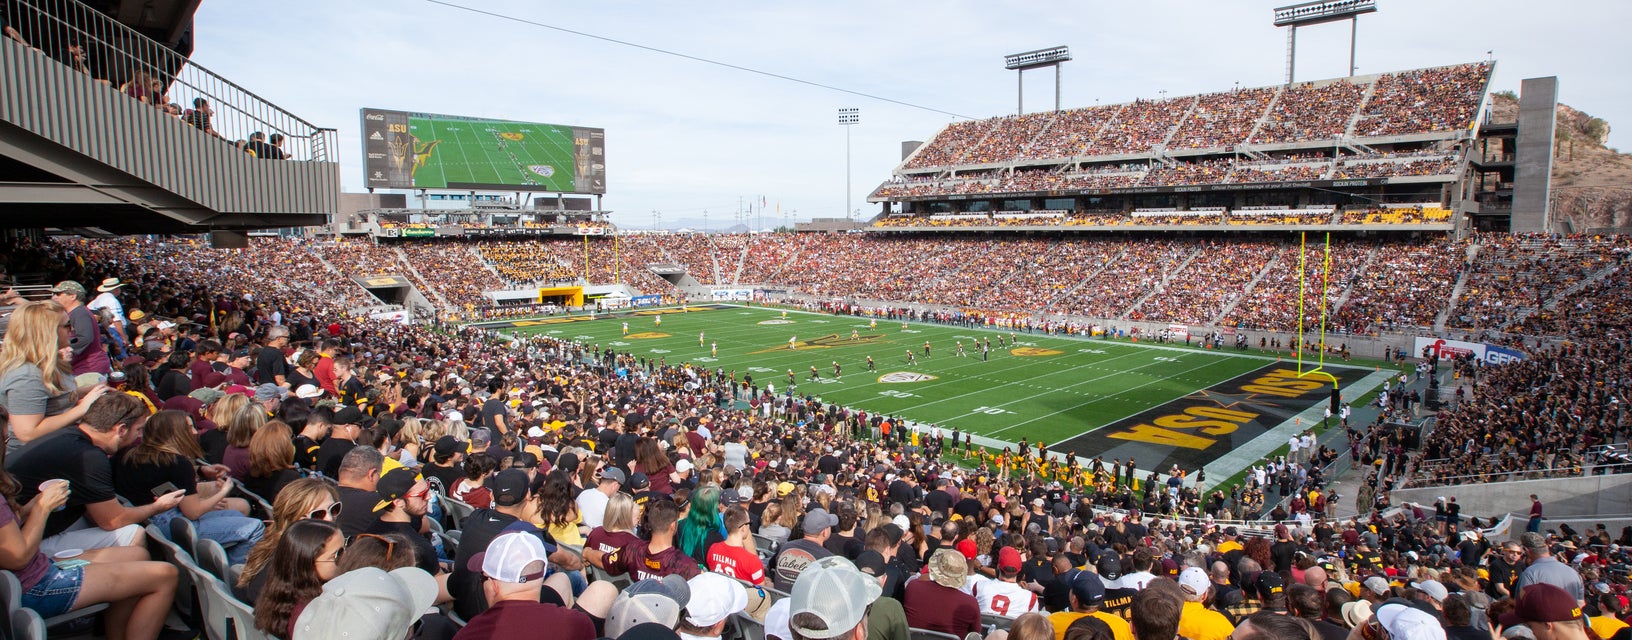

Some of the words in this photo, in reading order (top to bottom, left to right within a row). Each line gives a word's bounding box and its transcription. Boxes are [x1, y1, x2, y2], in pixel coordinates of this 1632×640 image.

[389, 124, 407, 133] ASU
[713, 553, 737, 567] TILLMAN
[778, 556, 808, 571] Cabel
[990, 594, 1011, 616] 9
[1103, 596, 1133, 608] TILLMA
